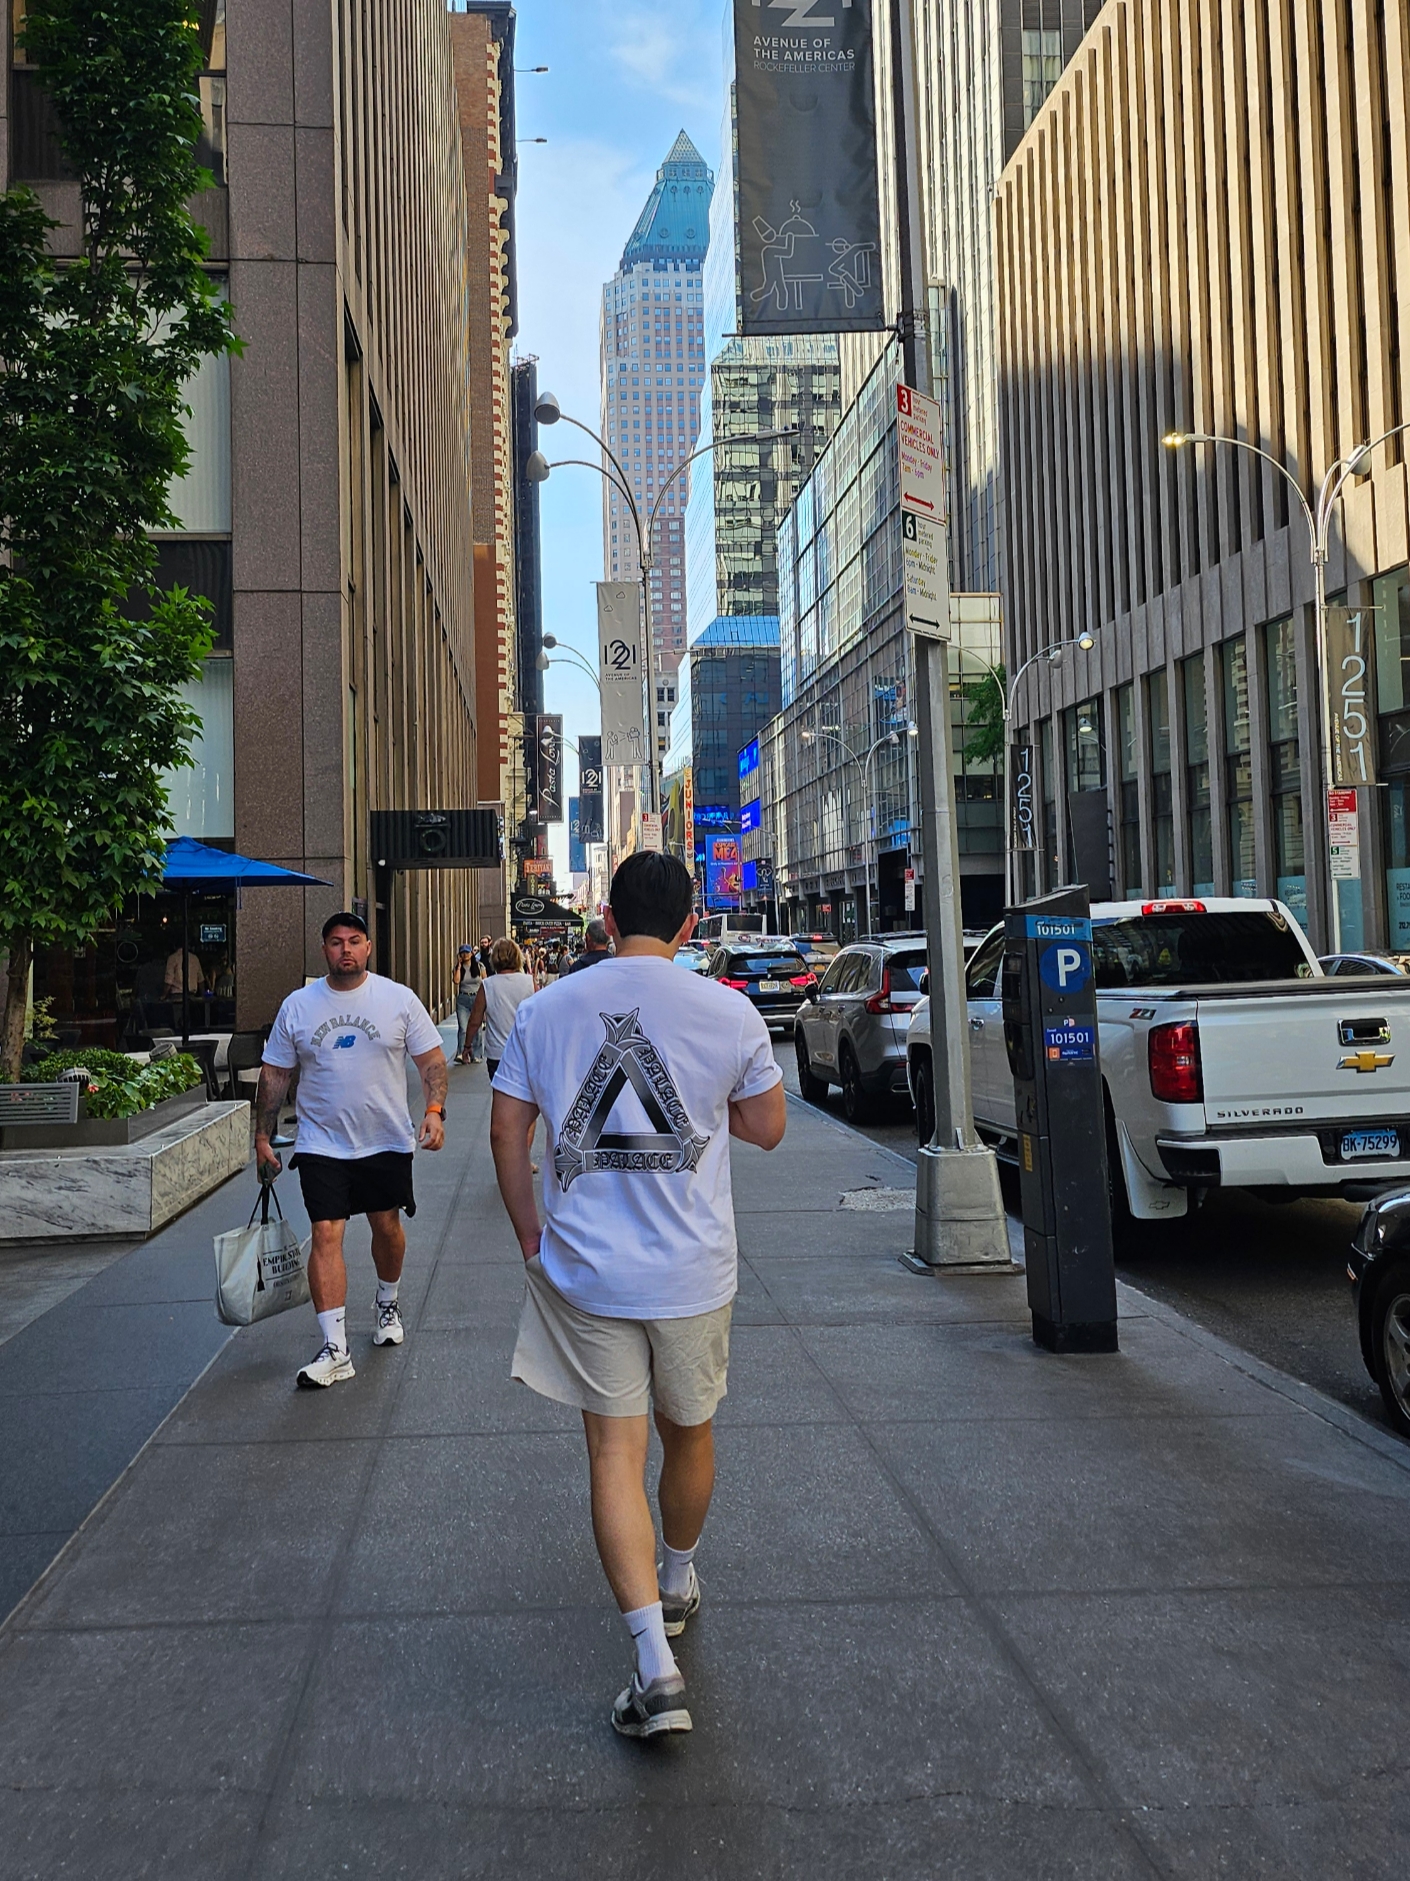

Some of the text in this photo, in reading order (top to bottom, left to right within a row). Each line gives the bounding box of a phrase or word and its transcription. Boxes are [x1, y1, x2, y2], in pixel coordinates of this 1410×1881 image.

[753, 36, 831, 48] AVENUE OF
[753, 48, 855, 61] THE AMERICAS
[753, 61, 856, 73] ROCKEFELLER CENTER
[900, 389, 909, 414] 3
[901, 420, 934, 445] COMMERCIAL
[901, 433, 940, 460] VEHICLES ONLY
[905, 516, 914, 539] 6
[905, 545, 922, 560] Monday
[925, 552, 938, 567] Friday
[906, 572, 926, 588] Saturday
[1341, 612, 1367, 782] 1251
[540, 767, 560, 808] Pasta
[1017, 748, 1032, 848] 1251
[1057, 949, 1081, 987] P
[310, 1014, 381, 1048] NEW BALANCE
[1050, 1032, 1089, 1044] 101501
[564, 1052, 614, 1141] PALACE
[636, 1047, 691, 1132] PALACE
[1217, 1106, 1304, 1119] SILVERADO
[592, 1151, 675, 1171] PALACE
